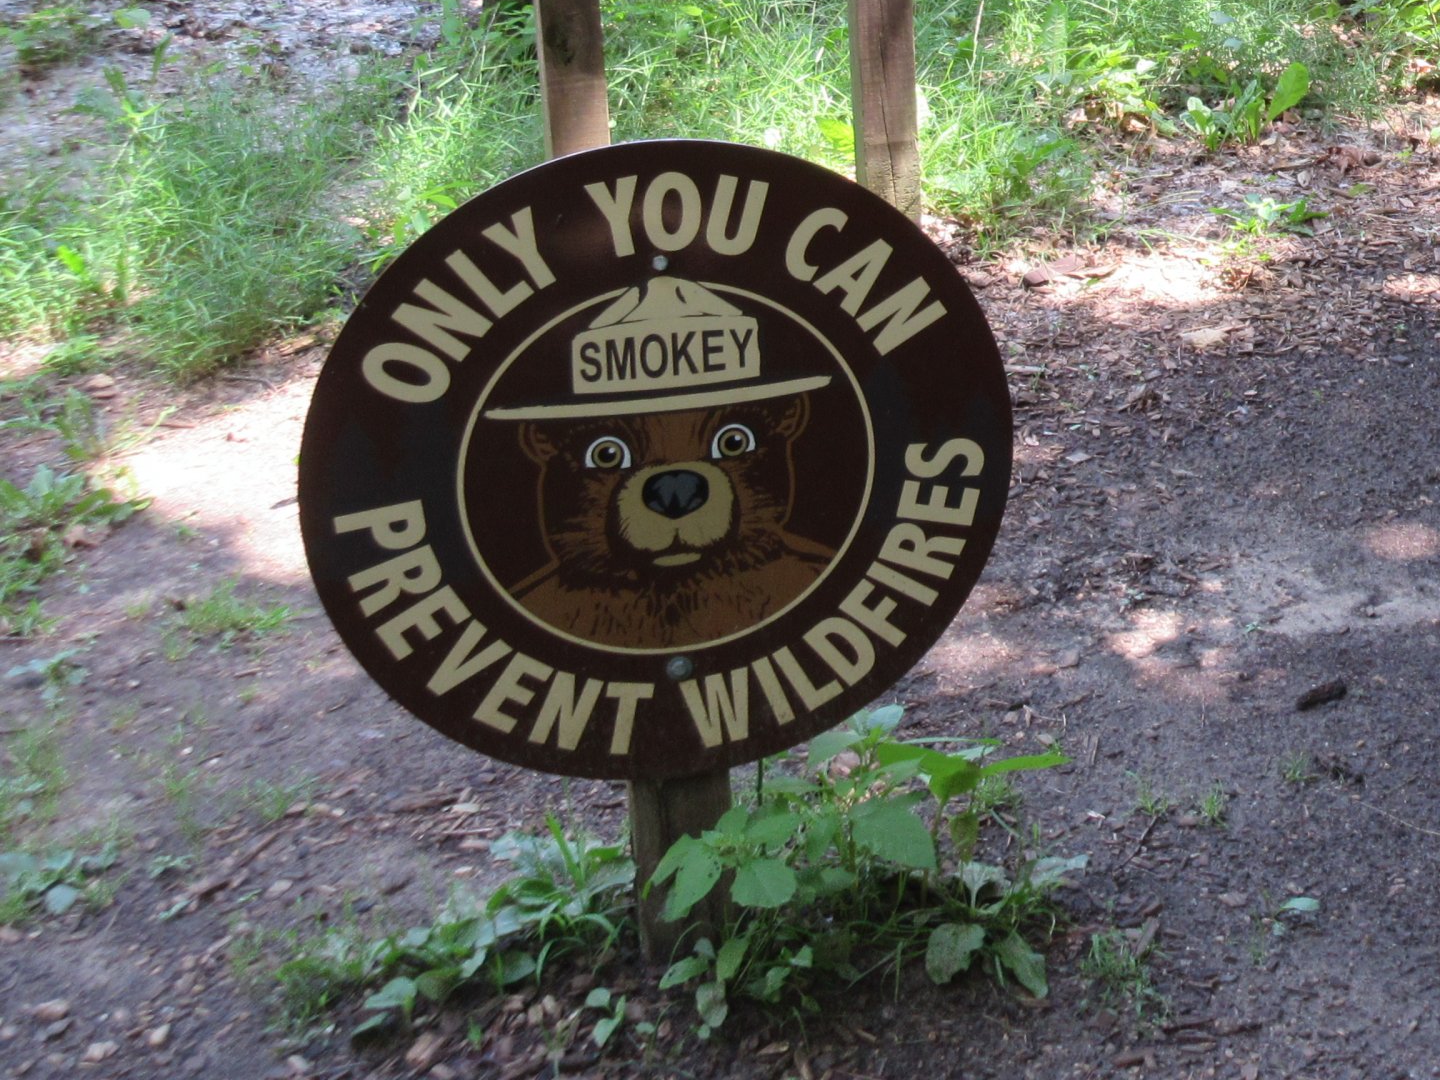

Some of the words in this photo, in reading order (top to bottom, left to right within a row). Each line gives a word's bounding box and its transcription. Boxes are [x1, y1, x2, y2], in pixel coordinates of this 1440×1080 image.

[361, 206, 557, 404] ONLY
[583, 171, 769, 258] YOU
[784, 207, 948, 357] CAN
[579, 328, 754, 383] SMOKEY
[333, 499, 655, 756] PREVENT
[678, 437, 986, 749] WILDFIRES
